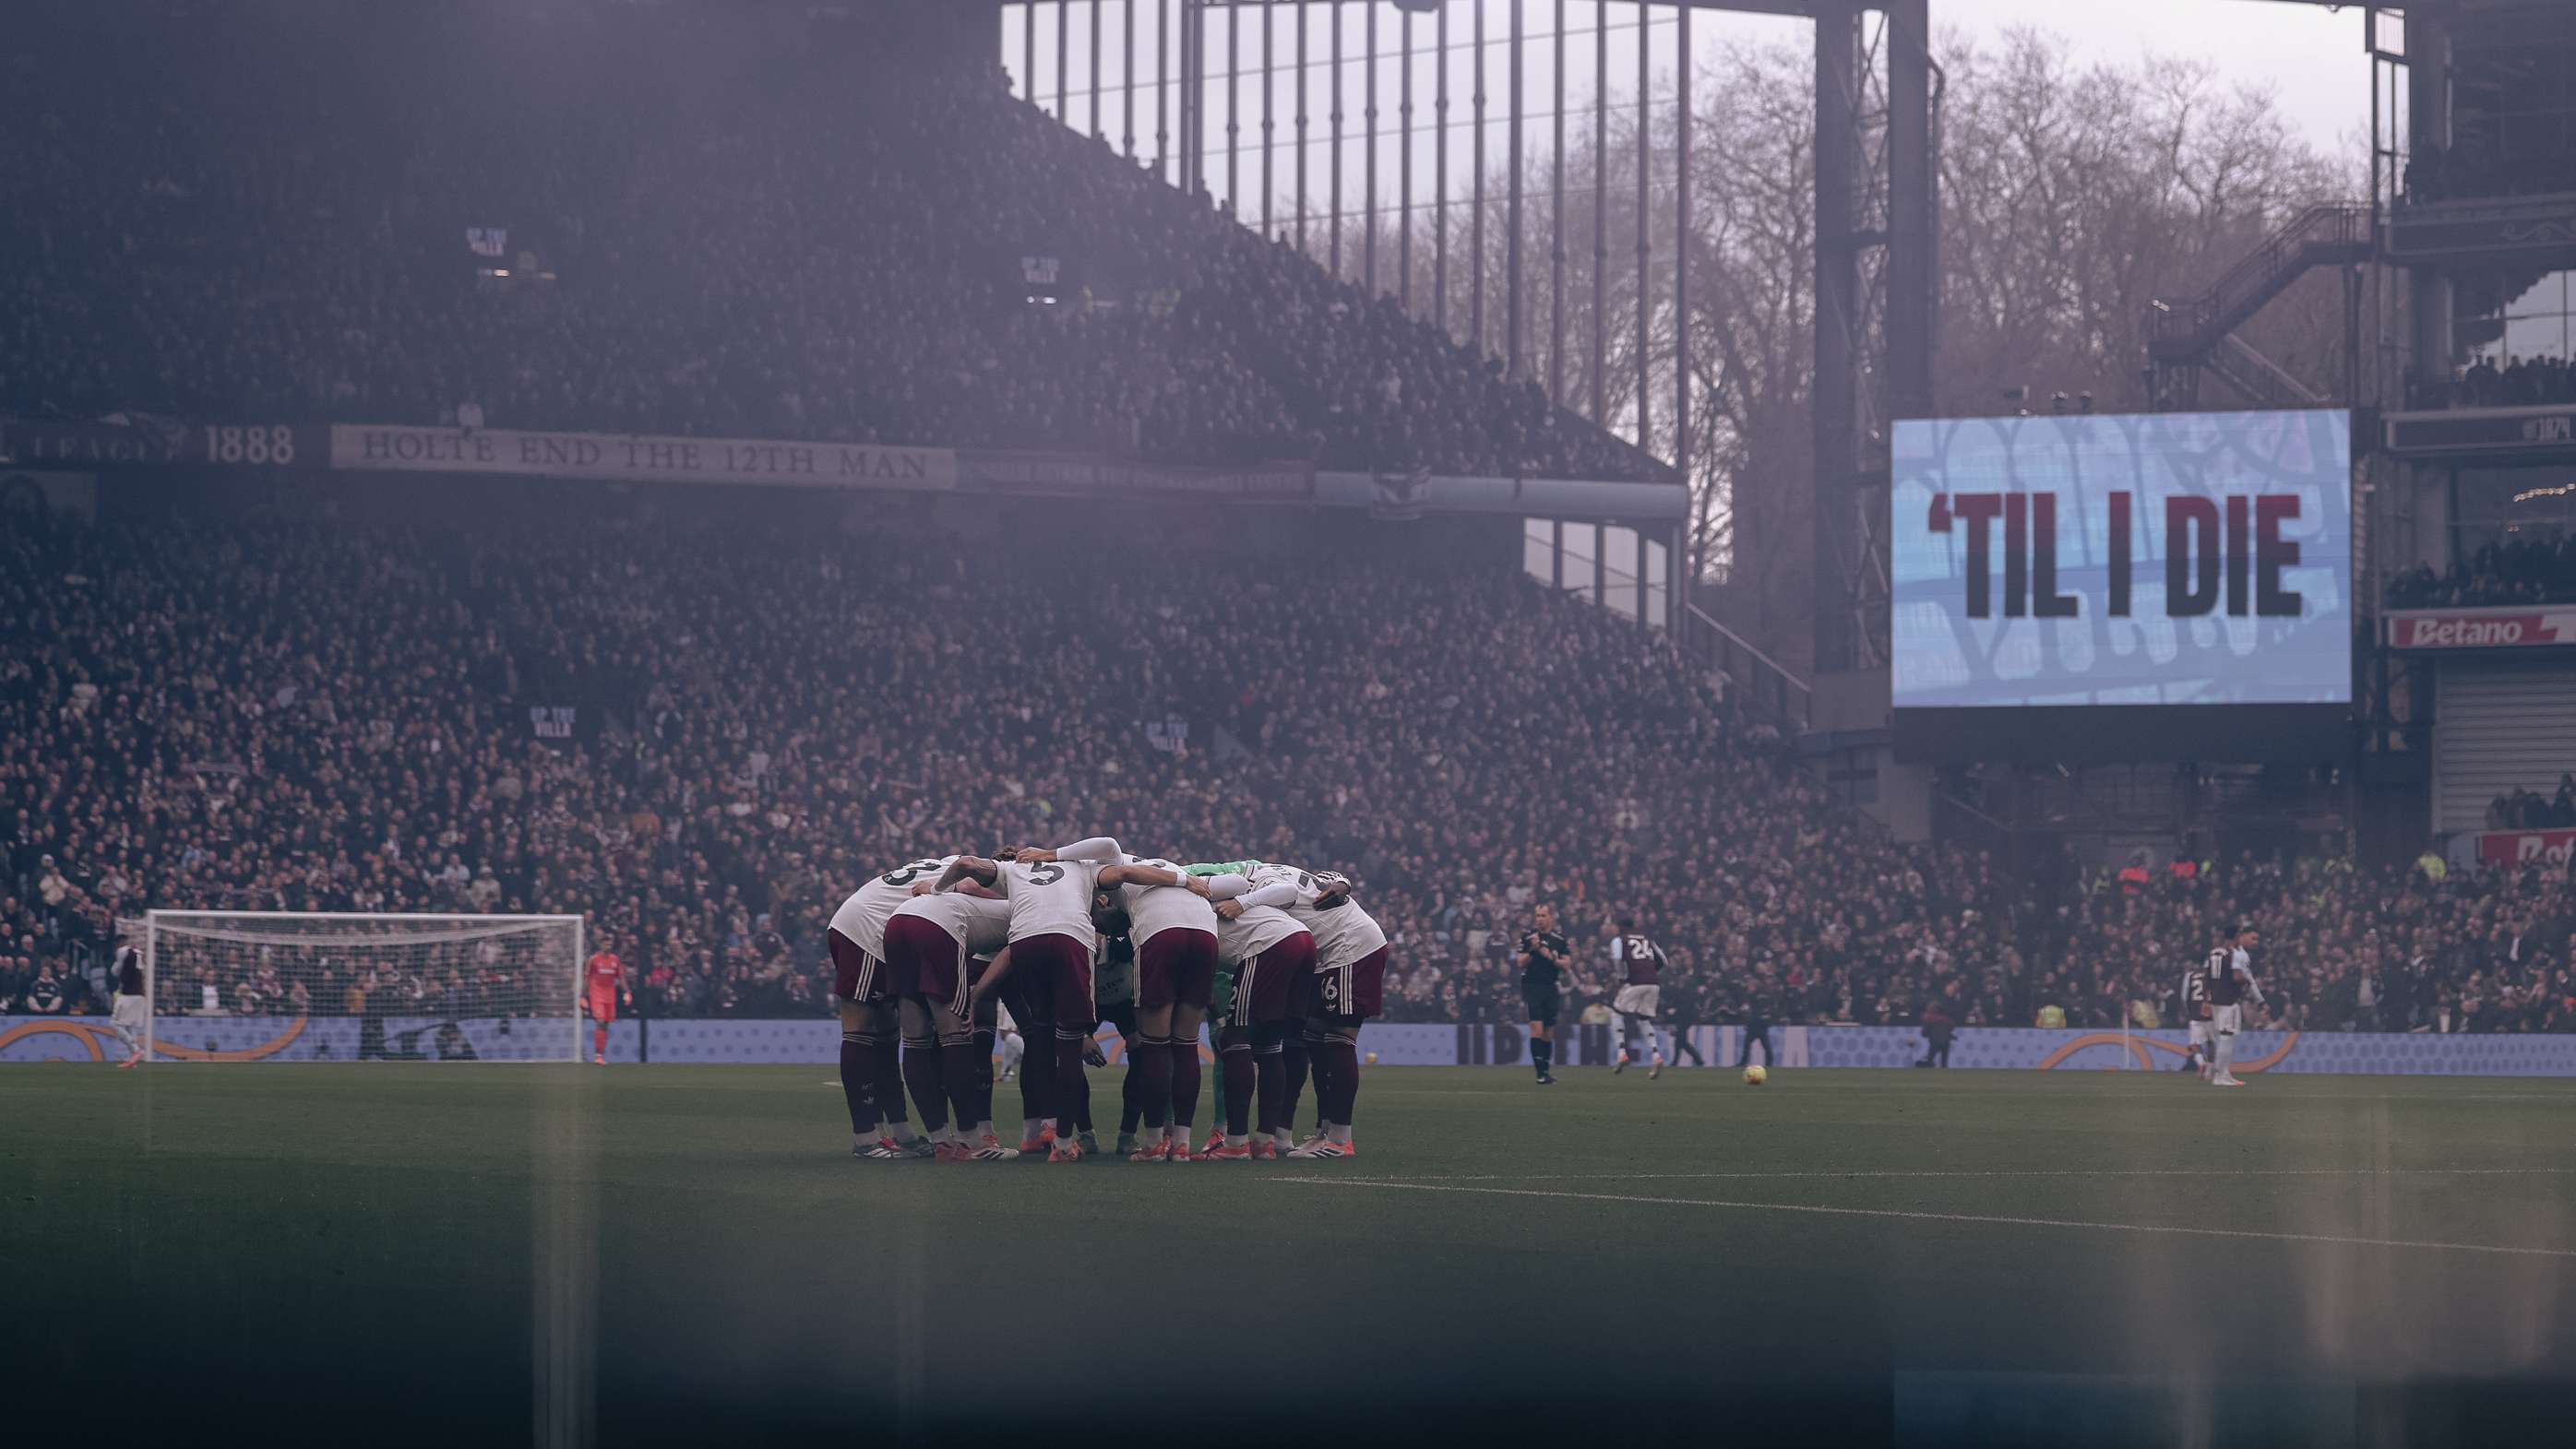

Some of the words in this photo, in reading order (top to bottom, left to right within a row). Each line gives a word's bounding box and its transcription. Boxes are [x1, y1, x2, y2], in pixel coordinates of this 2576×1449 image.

[205, 425, 294, 463] 1888
[361, 431, 495, 461] HOLTE
[519, 435, 600, 466] END
[619, 441, 702, 471] THE
[723, 445, 816, 474] 12TH
[839, 447, 928, 479] MAN
[2108, 491, 2131, 617] I
[2165, 493, 2302, 617] DIE
[2412, 617, 2523, 645] Betano
[1028, 860, 1065, 886] 5
[1627, 939, 1654, 960] 24
